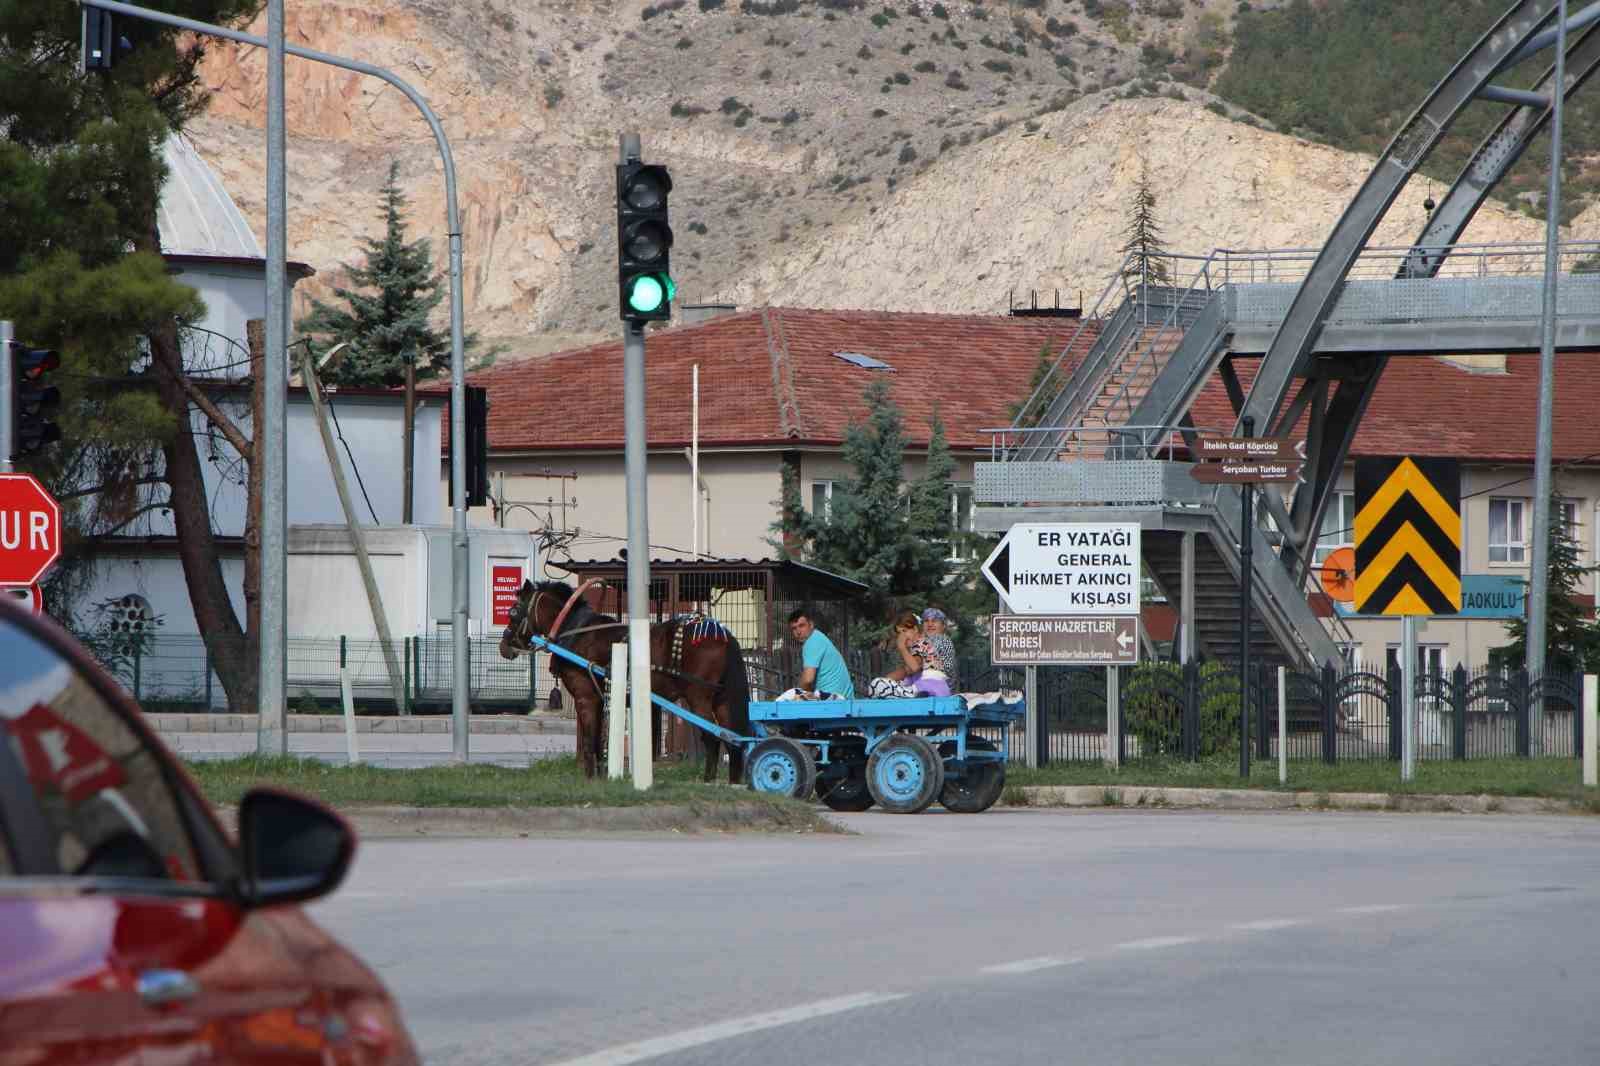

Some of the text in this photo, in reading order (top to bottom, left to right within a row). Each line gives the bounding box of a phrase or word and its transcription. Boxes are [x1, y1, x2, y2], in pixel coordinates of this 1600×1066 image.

[1229, 442, 1245, 450] Gazi
[1247, 441, 1279, 451] Köprüsü
[1222, 465, 1258, 474] Serçoban
[1038, 528, 1131, 547] ER YATAĞI
[1057, 553, 1132, 567] GENERAL
[1013, 570, 1131, 586] HİKMET AKINCI
[1071, 592, 1131, 607] KIŞLASI
[999, 621, 1053, 634] SERÇOBAN
[999, 635, 1042, 649] TÜRBESİ
